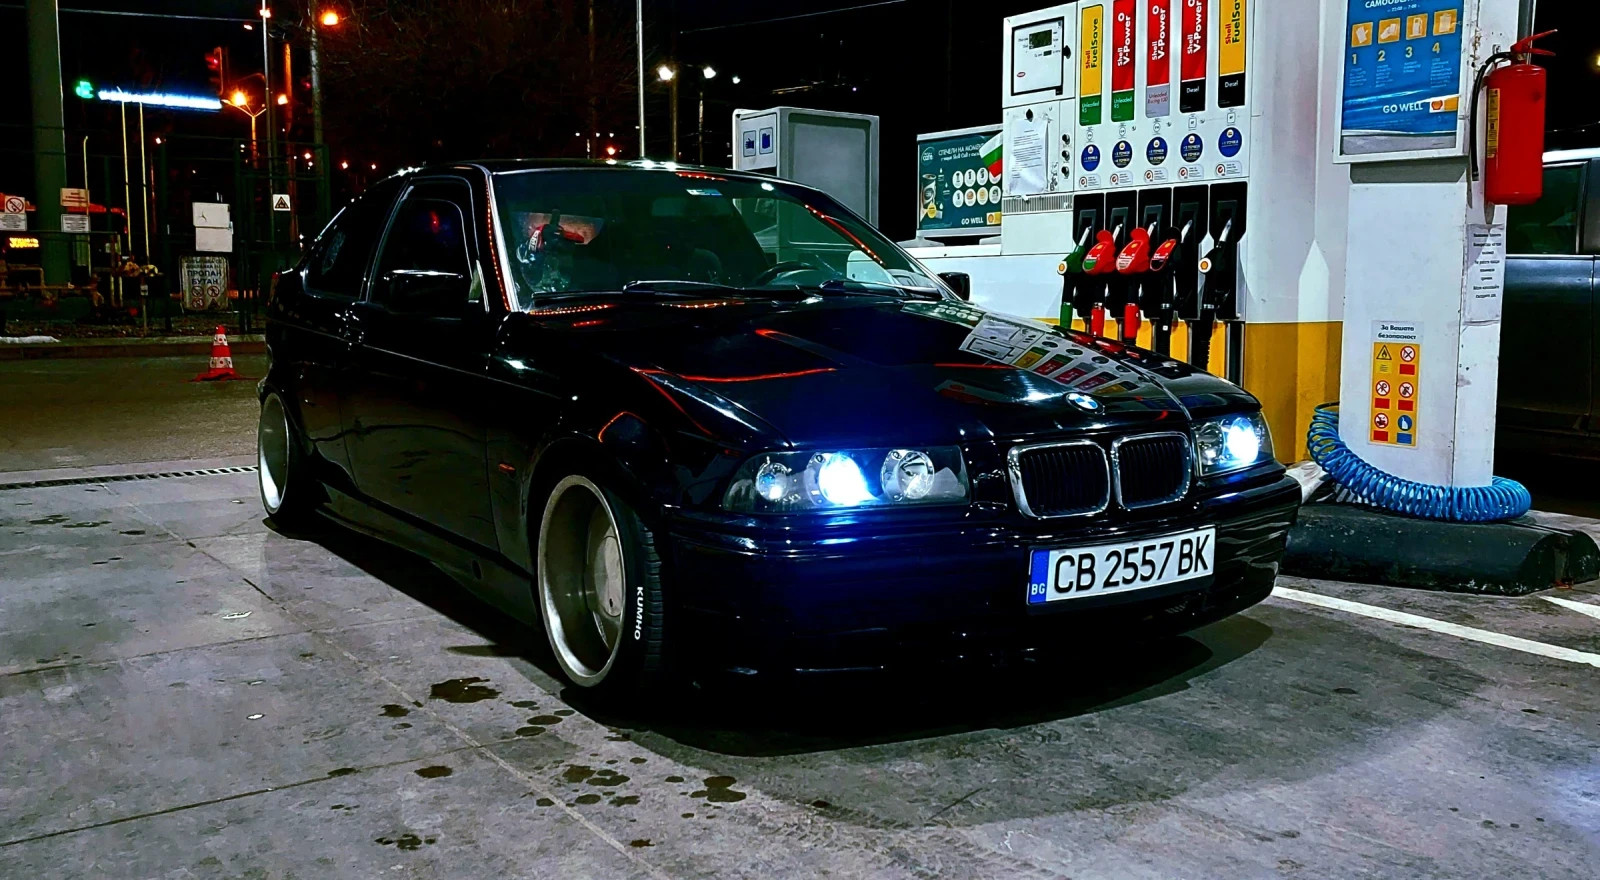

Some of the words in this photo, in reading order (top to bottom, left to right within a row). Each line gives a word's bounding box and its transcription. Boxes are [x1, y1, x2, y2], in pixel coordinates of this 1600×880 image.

[1193, 0, 1202, 53] V-Power
[1123, 15, 1131, 65] V-Power
[1157, 8, 1166, 60] V-Power
[1091, 18, 1099, 68] FuelSave
[1432, 42, 1440, 54] 4
[1377, 50, 1386, 62] 2
[1405, 46, 1413, 58] 3
[1351, 53, 1357, 65] 1
[1186, 86, 1200, 94] Diesel
[1225, 80, 1239, 88] Diesel
[1113, 96, 1132, 104] Unleaded
[1149, 91, 1168, 99] Unleaded
[1081, 101, 1100, 109] Unleaded
[1382, 104, 1398, 114] GO
[1399, 102, 1424, 112] WELL
[1378, 332, 1417, 340] безопасност
[1031, 583, 1046, 595] BG
[1053, 552, 1096, 594] CB
[1102, 541, 1175, 589] 2557
[1177, 534, 1211, 576] BK
[634, 586, 644, 640] KUMHO
